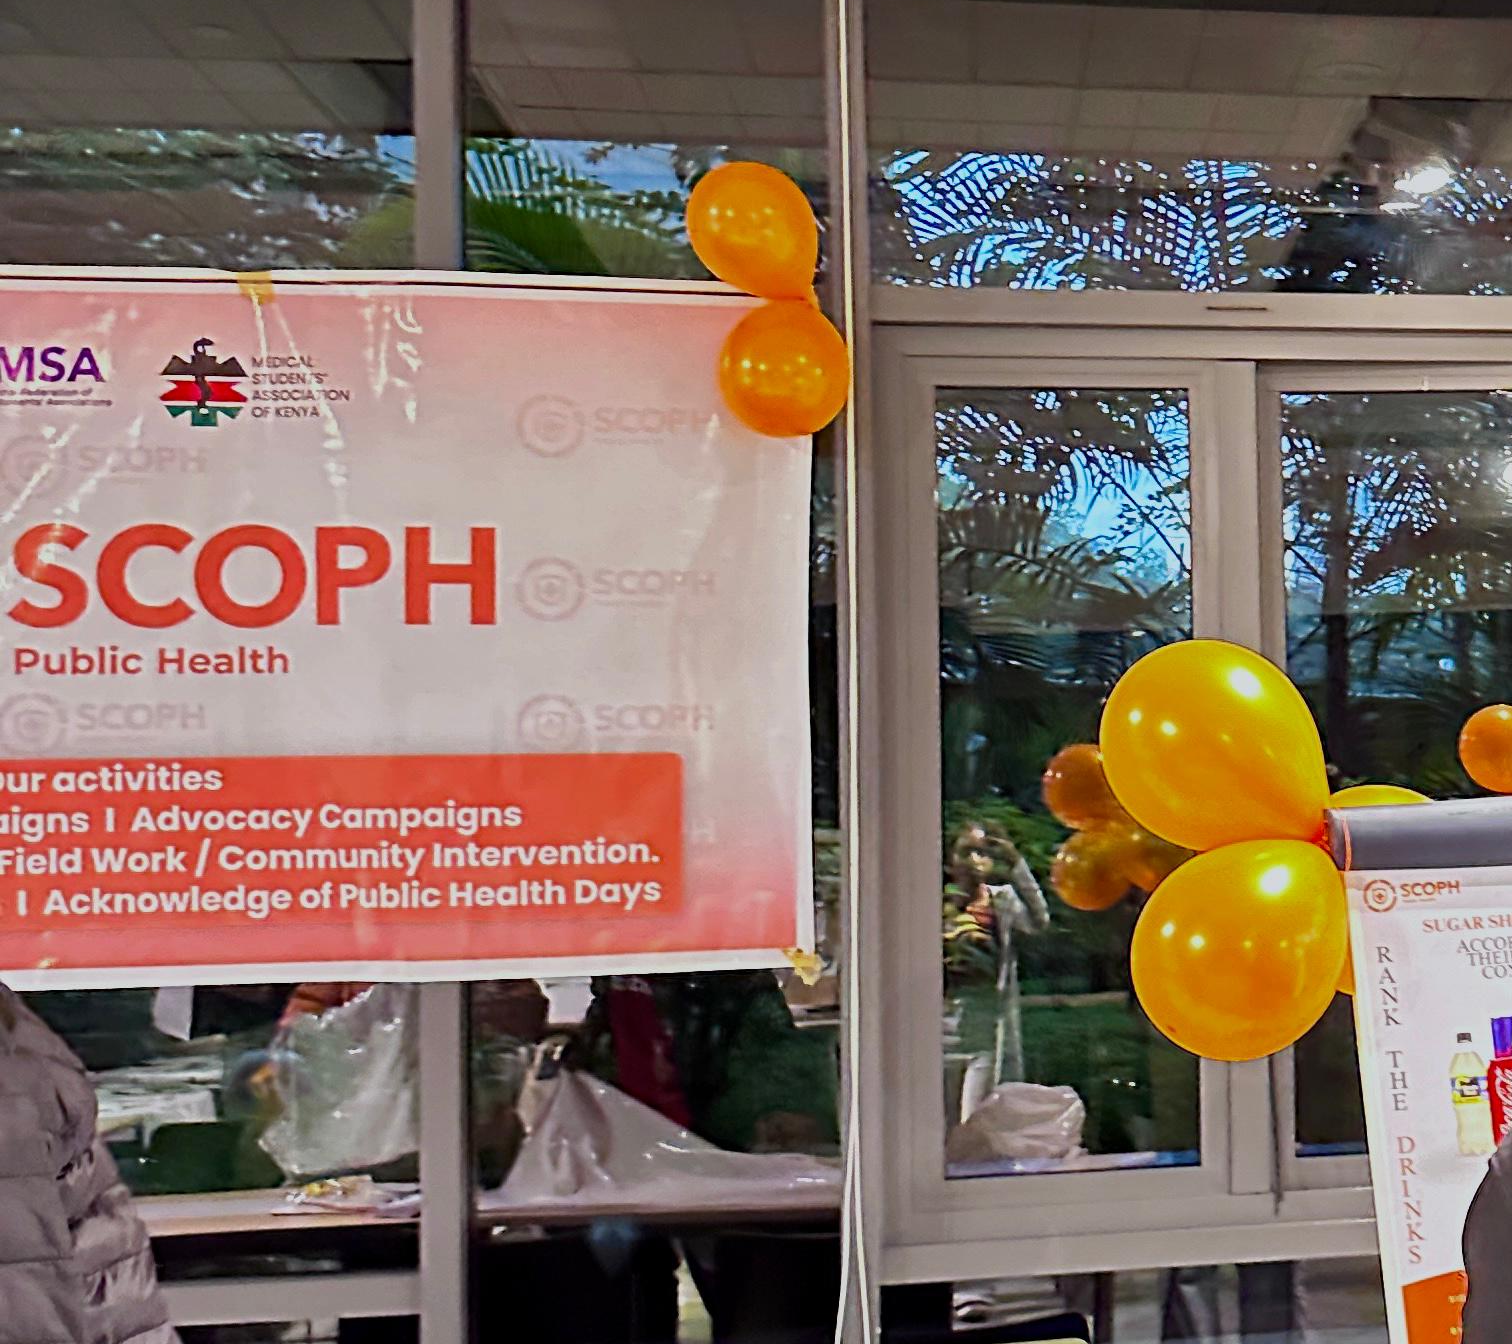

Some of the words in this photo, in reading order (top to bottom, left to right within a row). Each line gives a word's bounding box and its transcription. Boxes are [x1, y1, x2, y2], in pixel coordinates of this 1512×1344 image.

[0, 346, 106, 383] MSA
[251, 355, 314, 368] MEDICAL
[251, 372, 328, 385] STUDENS'
[251, 389, 350, 401] ASSOCIATION
[251, 406, 271, 418] OF
[275, 406, 320, 418] KENYA
[6, 522, 497, 630] SCOPH
[13, 645, 143, 675] Public
[157, 645, 290, 675] Health
[76, 702, 206, 731] SCOPH
[594, 703, 715, 731] SCOPH
[51, 763, 224, 793] activities
[131, 804, 313, 839] Advocacy
[319, 799, 523, 837] Campaigns
[90, 844, 188, 874] Work
[218, 839, 425, 877] Community
[432, 835, 661, 868] Intervention.
[43, 884, 293, 919] Acknowledge
[299, 880, 334, 909] of
[338, 879, 441, 910] Public
[448, 879, 566, 908] Health
[574, 878, 662, 911] Days
[1400, 880, 1460, 897] SCOPH
[1422, 916, 1486, 934] SUGAR
[1376, 946, 1401, 1026] RANK
[1386, 1051, 1409, 1111] THE
[1396, 1136, 1426, 1265] DRINKS
